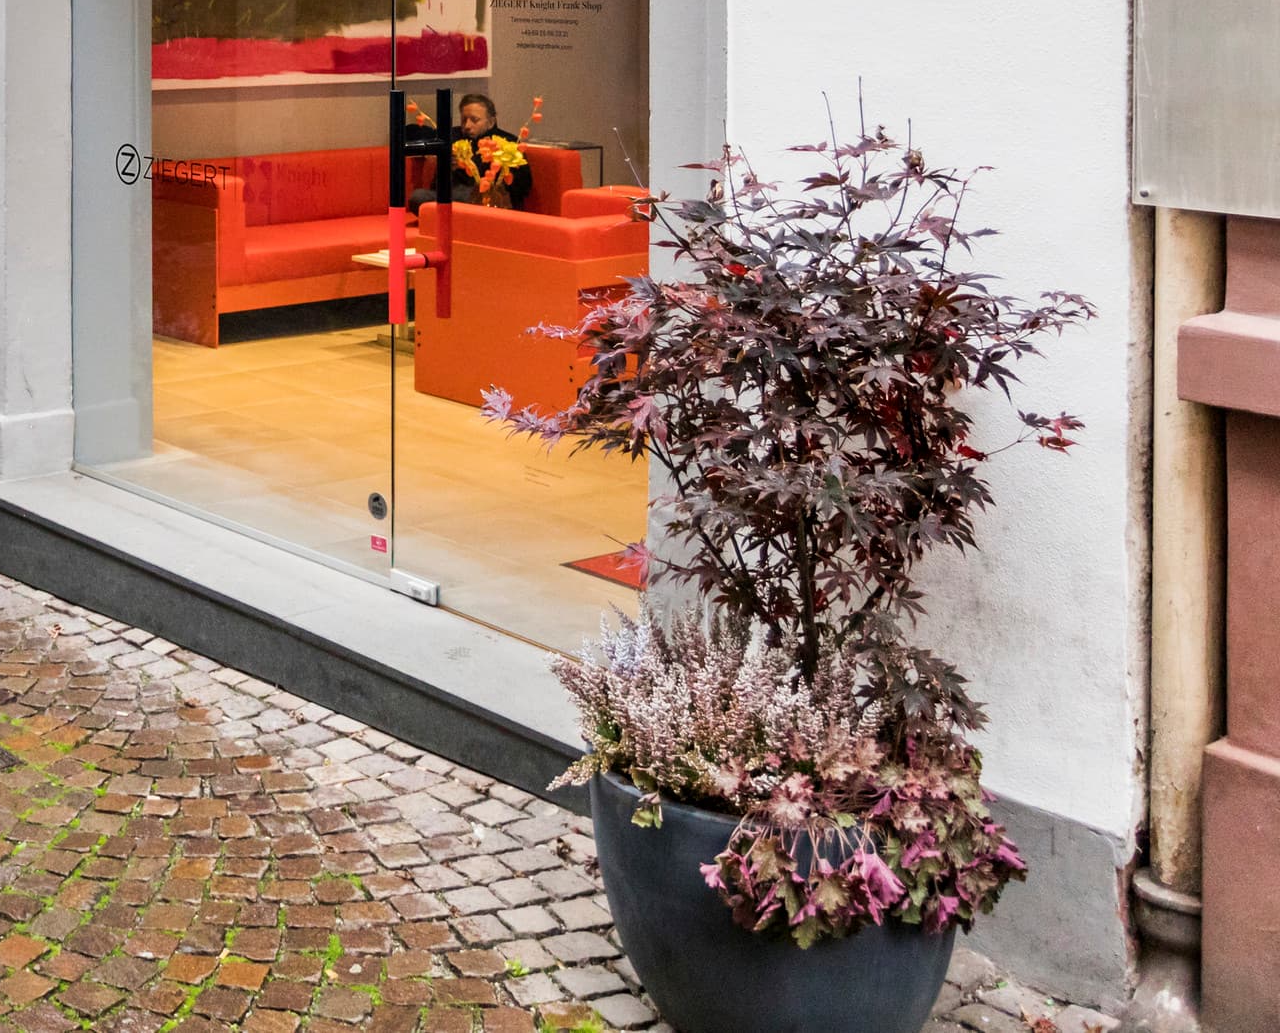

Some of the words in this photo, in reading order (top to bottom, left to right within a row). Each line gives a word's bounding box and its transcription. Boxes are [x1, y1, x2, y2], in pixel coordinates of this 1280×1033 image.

[490, 0, 528, 9] ZIEGERT
[529, 0, 555, 11] Knight
[557, 0, 580, 10] Frank
[582, 1, 602, 13] Shop
[143, 156, 231, 190] ZIEGERT
